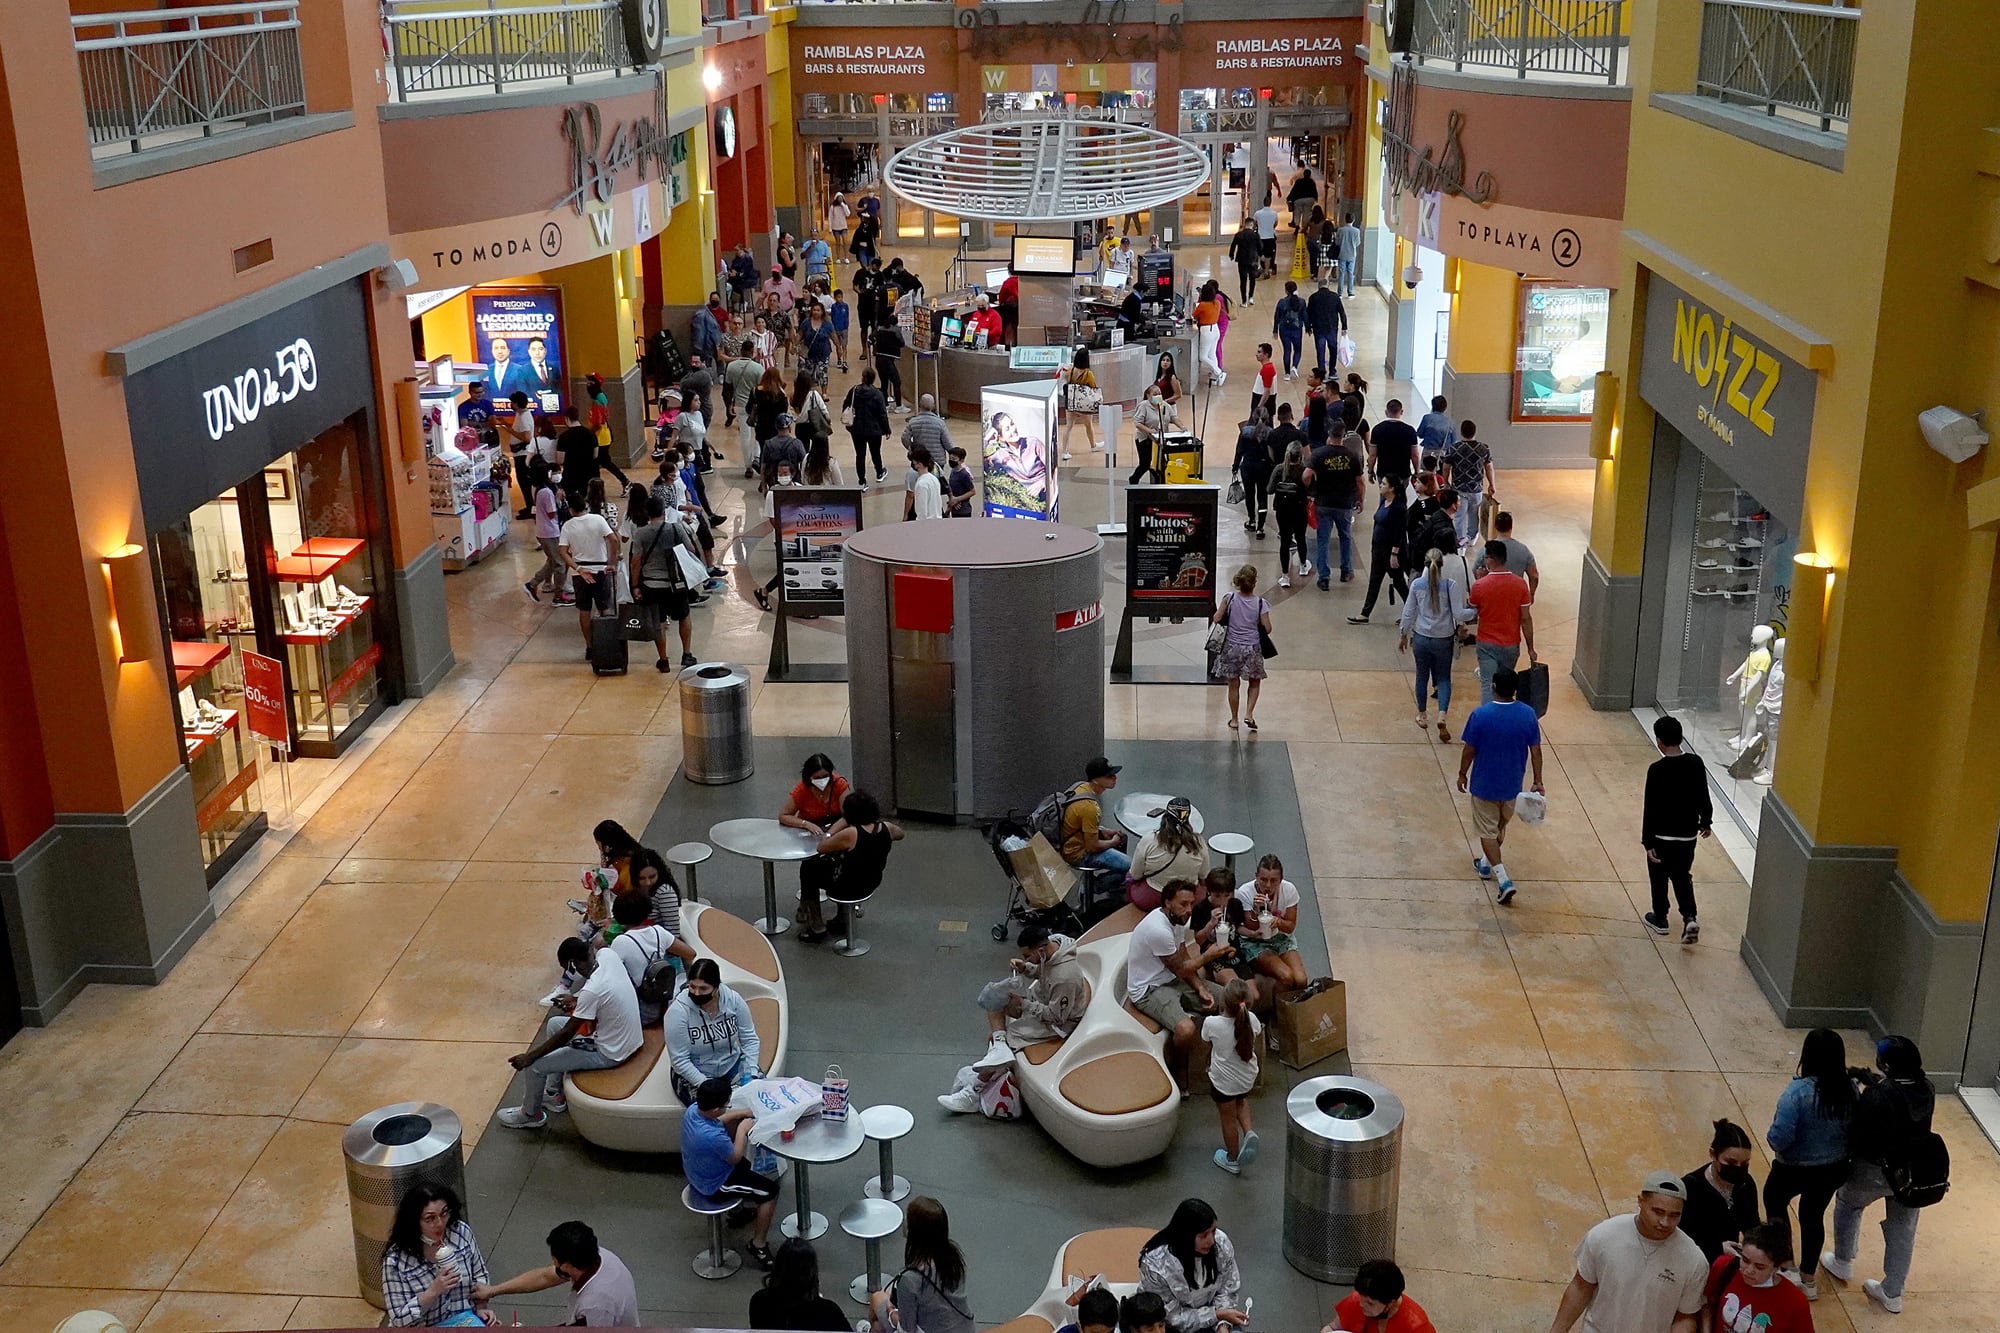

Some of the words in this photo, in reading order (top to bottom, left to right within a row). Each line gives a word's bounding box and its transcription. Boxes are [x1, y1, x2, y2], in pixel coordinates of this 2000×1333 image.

[1216, 39, 1290, 53] RAMBLAS
[1294, 38, 1342, 51] PLAZA
[804, 46, 873, 60] RAMBLAS
[876, 46, 925, 60] PLAZA
[805, 64, 835, 74] BARS
[836, 64, 843, 74] &
[845, 64, 926, 75] RESTAURANTS
[1216, 59, 1247, 69] BARS
[1250, 59, 1258, 68] &
[1260, 56, 1342, 68] RESTAURANTS
[984, 67, 1150, 89] WALK
[1458, 221, 1477, 239] TO
[1484, 226, 1541, 252] PLAYA
[1560, 238, 1573, 259] 2
[433, 249, 462, 268] TO
[473, 238, 532, 262] MODA
[547, 230, 556, 249] 4
[476, 314, 544, 323] ¿ACCIDENTE
[545, 314, 555, 323] O
[482, 322, 551, 332] LESIONADO?
[203, 367, 261, 441] UNO
[263, 367, 280, 407] de
[276, 338, 318, 404] 50
[1697, 404, 1710, 425] BY
[1708, 413, 1734, 447] MANIA
[796, 520, 842, 528] LOCATIONS
[798, 513, 817, 521] NOW
[1140, 516, 1188, 528] Photos
[1146, 531, 1186, 543] Santa
[1073, 602, 1097, 626] ATM
[688, 1014, 739, 1045] PINK
